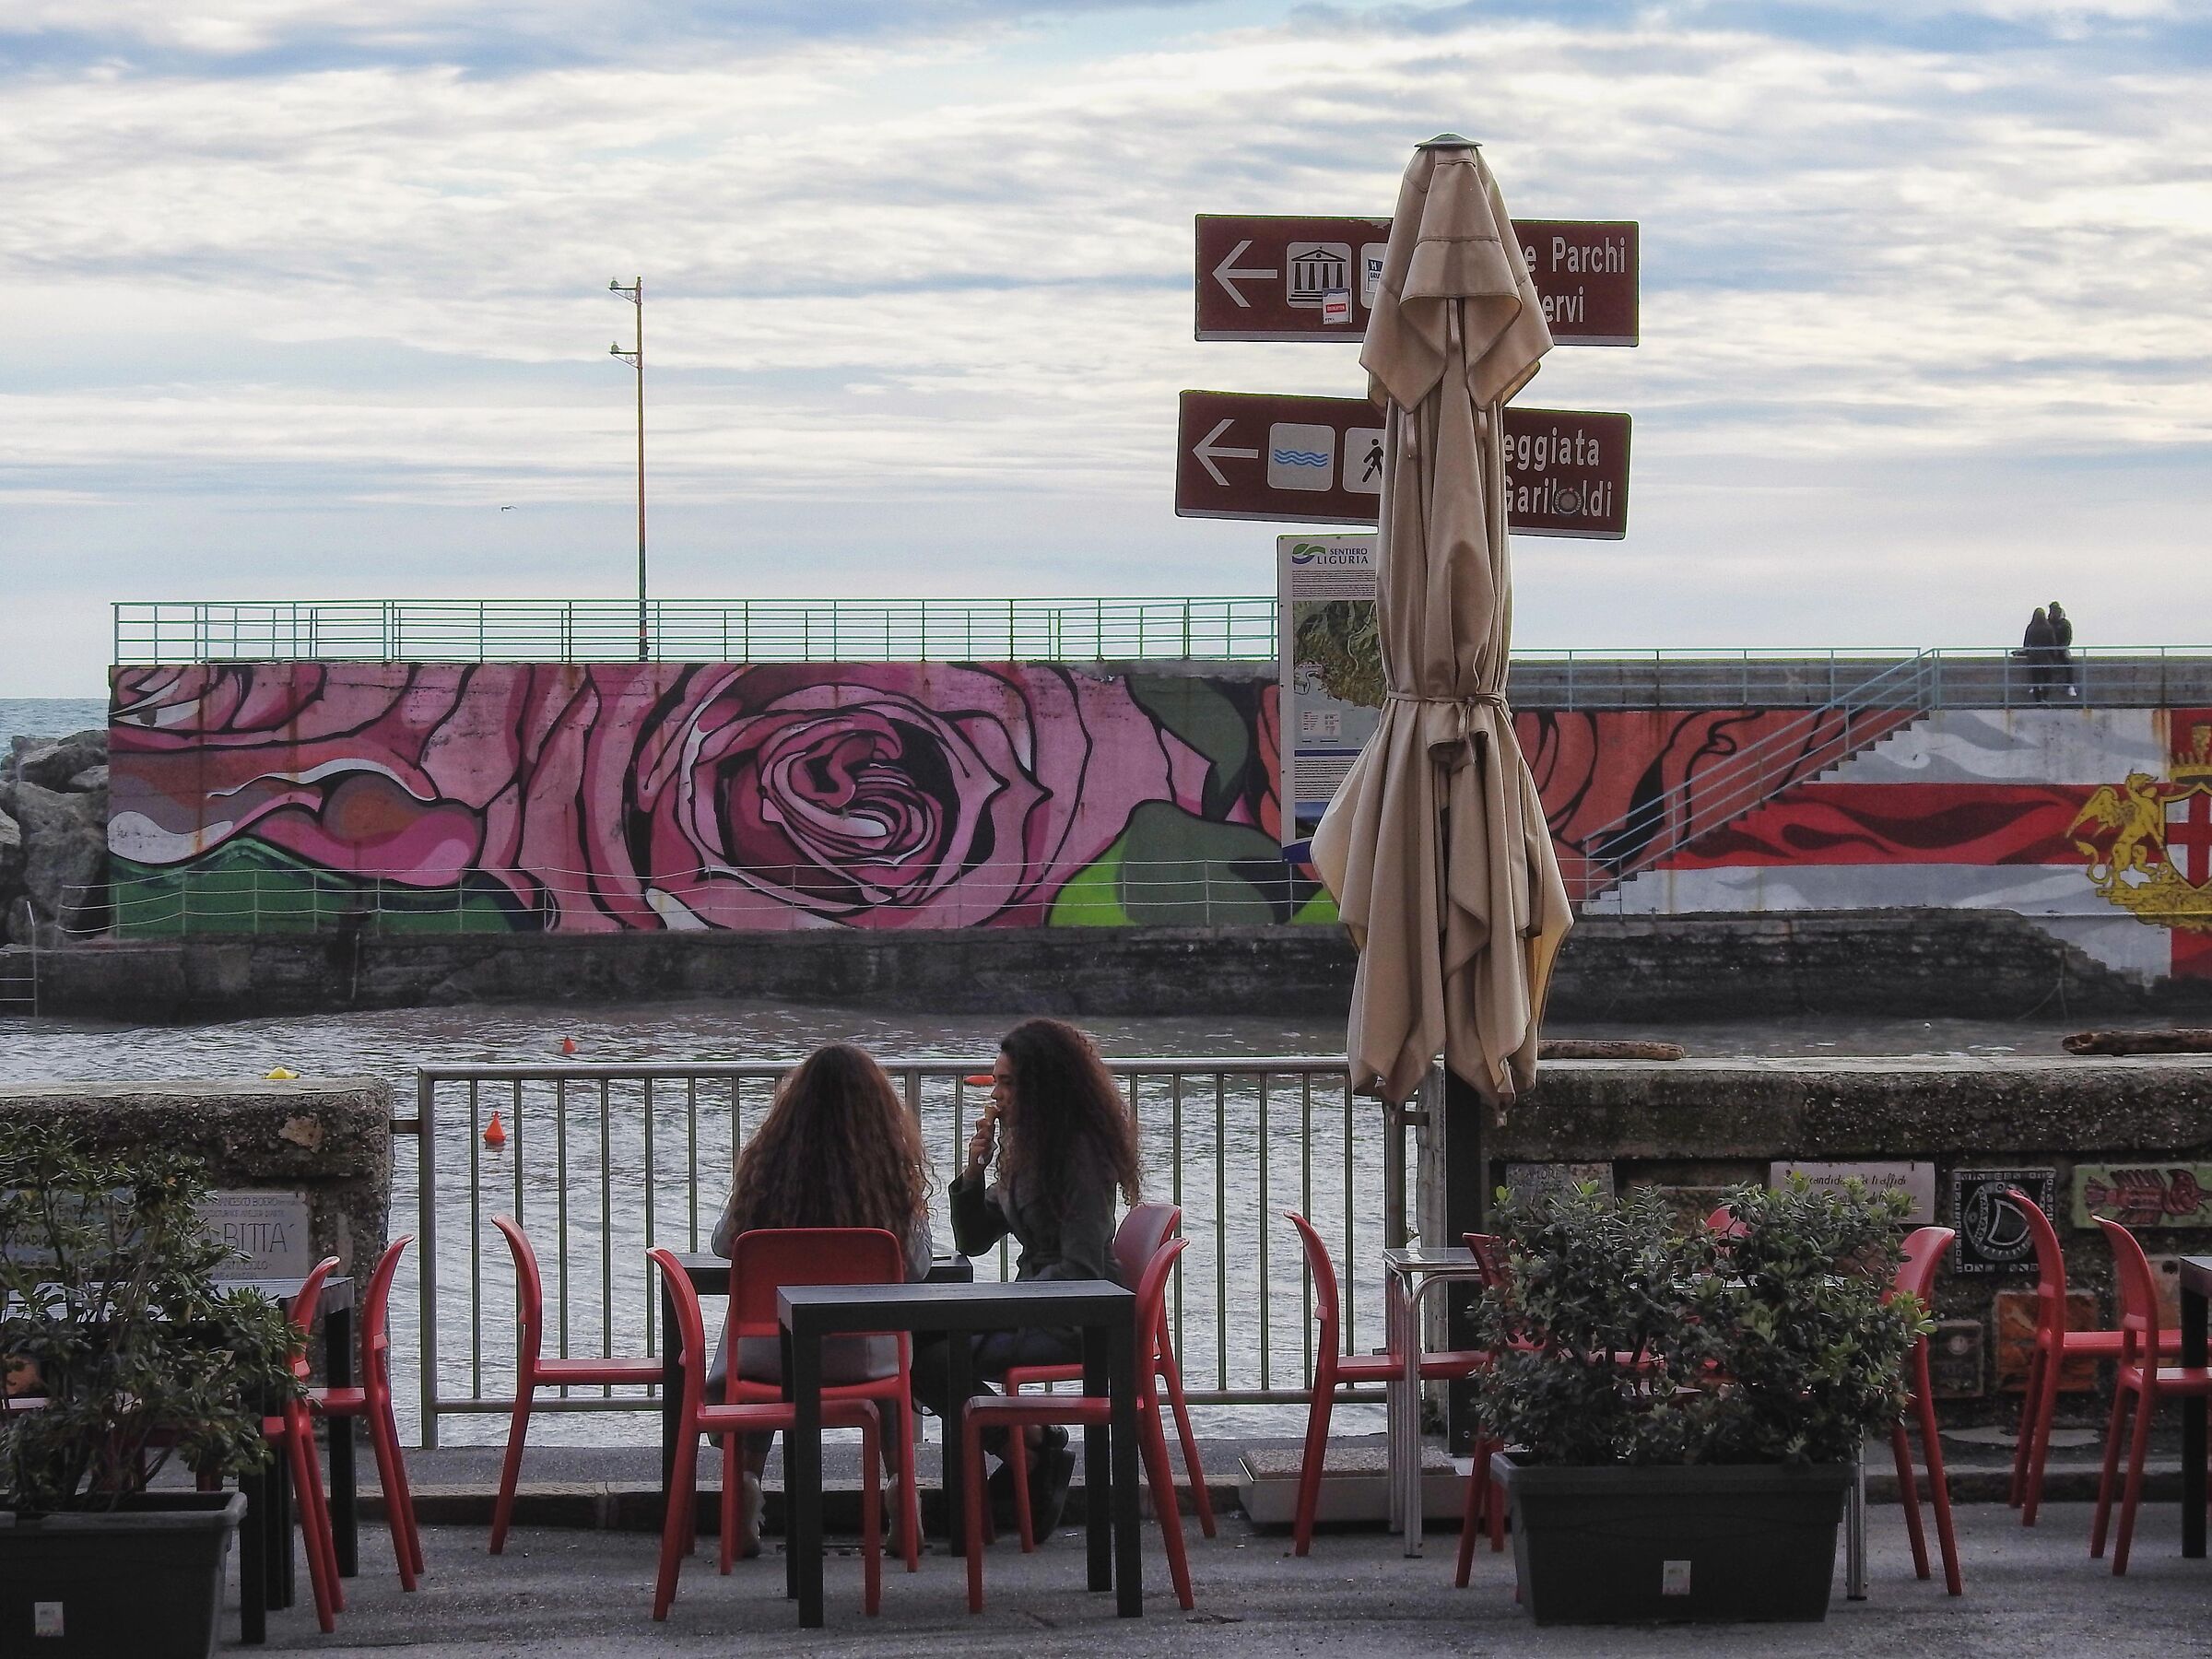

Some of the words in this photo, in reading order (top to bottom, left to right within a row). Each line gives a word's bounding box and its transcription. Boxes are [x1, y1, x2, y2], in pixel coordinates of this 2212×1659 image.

[1552, 236, 1625, 273] Parchi
[1535, 286, 1585, 323] ervi
[1317, 555, 1369, 565] LIGURIA
[1329, 547, 1368, 556] SENTIERO
